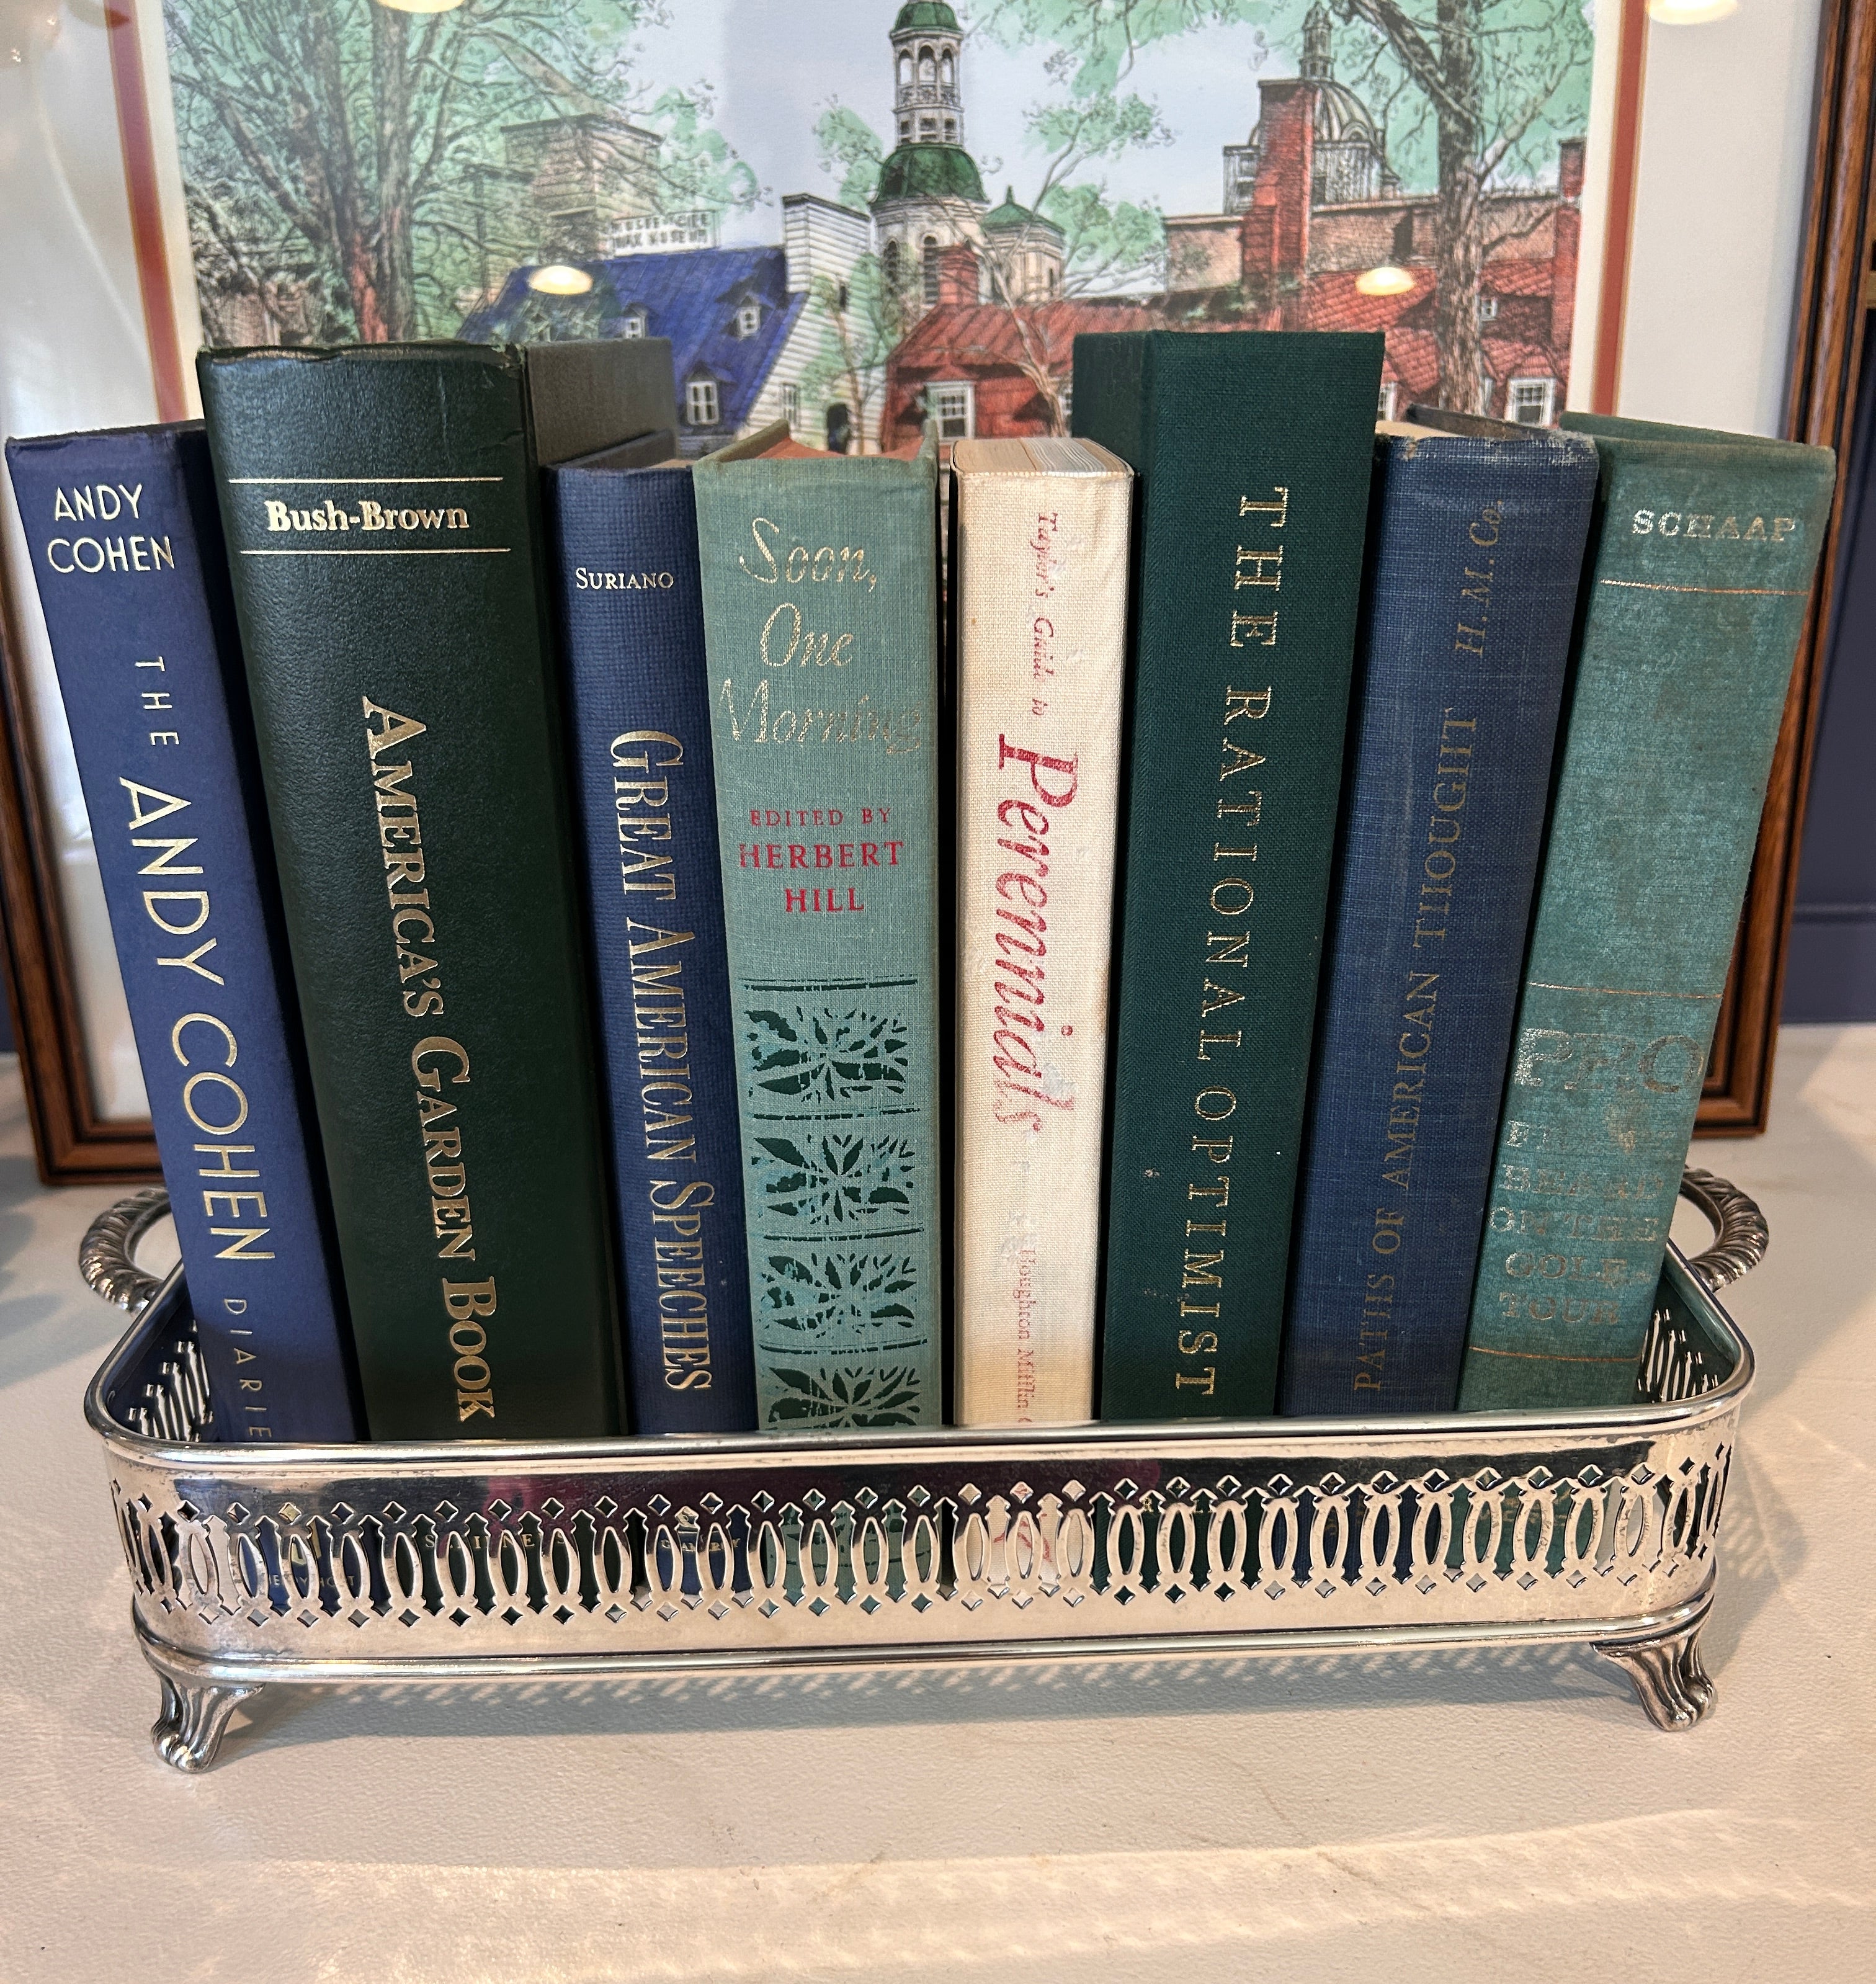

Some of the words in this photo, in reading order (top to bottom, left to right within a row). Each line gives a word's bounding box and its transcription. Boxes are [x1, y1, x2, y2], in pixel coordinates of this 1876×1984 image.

[47, 535, 176, 574] COHEN
[54, 483, 143, 522] ANDY
[264, 499, 470, 532] Bush-Brown
[739, 517, 877, 593] Soon,
[1632, 507, 1797, 542] SCHAAP
[575, 567, 674, 590] SURIANO
[1229, 485, 1290, 648] THE
[759, 602, 854, 668] One
[135, 656, 180, 746] THE
[718, 677, 922, 755] Morning
[362, 695, 444, 1017] AMERICA'S
[609, 730, 684, 901] GREAT
[738, 841, 904, 869] HERBERT
[748, 808, 844, 828] EDITED
[861, 807, 891, 825] BY
[118, 776, 225, 986] ANDY
[784, 887, 865, 913] HILL
[1197, 684, 1272, 1061] RATIONAL
[992, 733, 1080, 1133] Perennials
[625, 916, 698, 1164] AMERICAN
[1381, 969, 1440, 1189] AMERICAN
[171, 1012, 275, 1261] COHEN
[411, 1035, 476, 1262] GARDEN
[1175, 1084, 1238, 1396] OPTIMIST
[1371, 1207, 1405, 1255] OF
[648, 1179, 715, 1392] SPEECHES
[1354, 1272, 1395, 1393] PATHS
[1498, 1290, 1621, 1327] TOUR
[442, 1275, 498, 1423] BOOK
